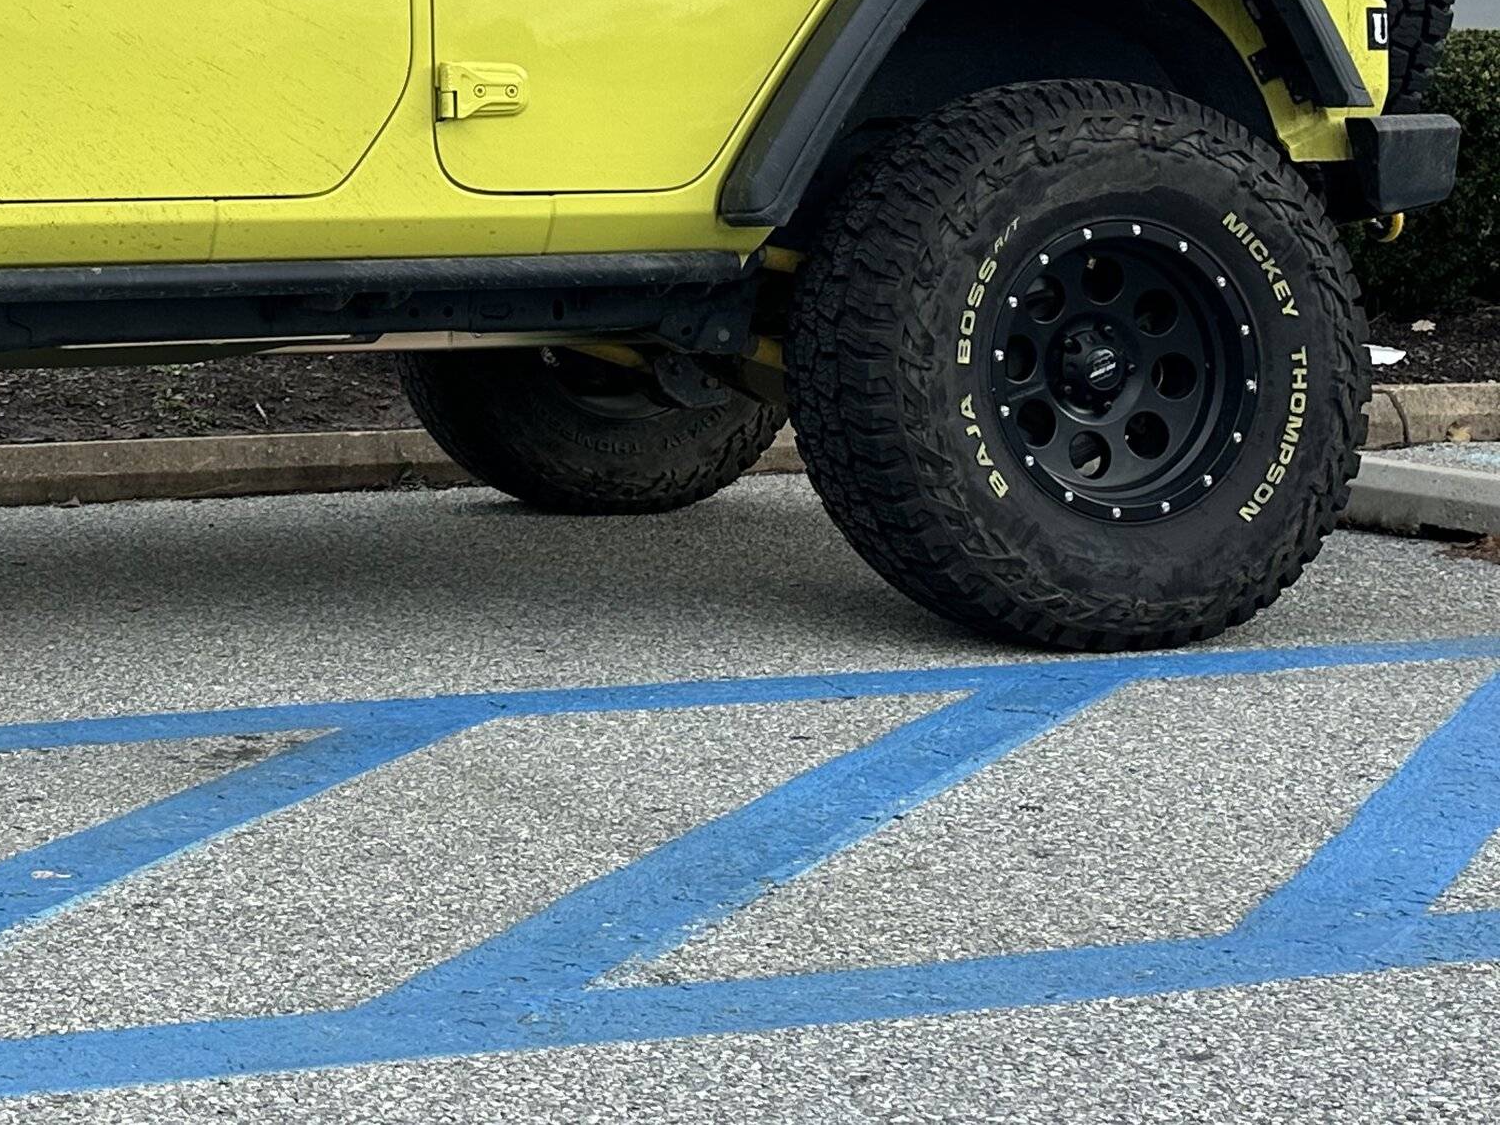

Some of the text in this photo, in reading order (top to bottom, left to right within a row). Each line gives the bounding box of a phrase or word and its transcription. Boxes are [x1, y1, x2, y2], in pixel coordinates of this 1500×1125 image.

[956, 256, 998, 365] BOSS
[1222, 211, 1308, 523] MICKEY THOMPSON
[959, 393, 1010, 499] BAJA
